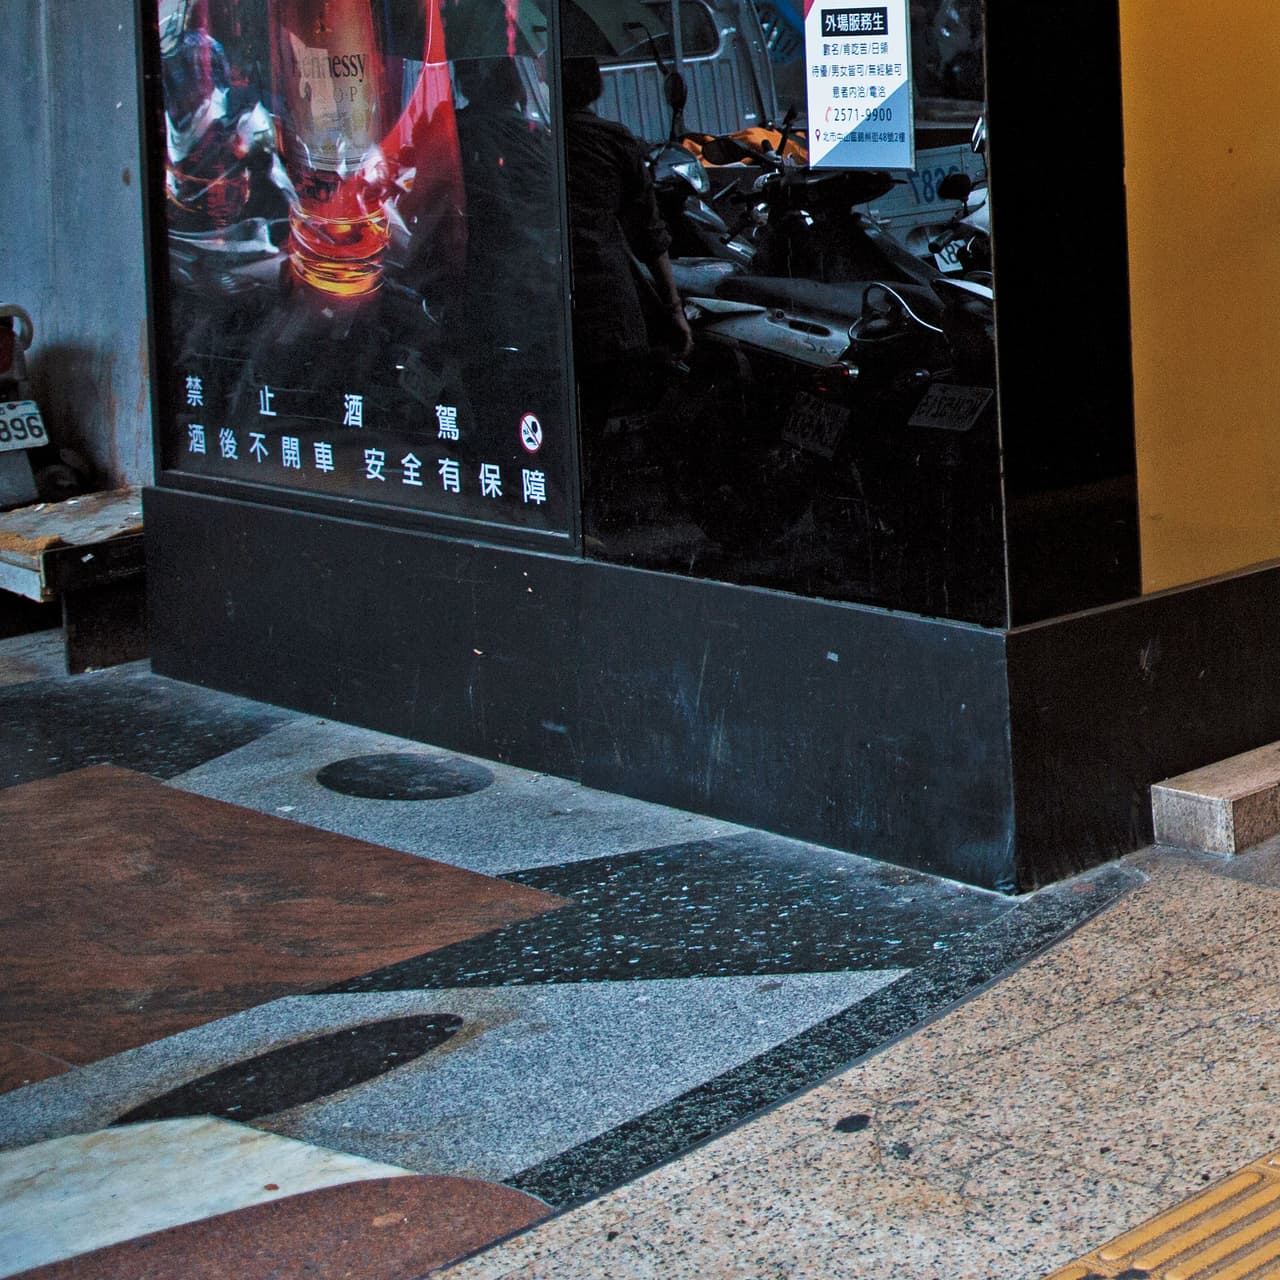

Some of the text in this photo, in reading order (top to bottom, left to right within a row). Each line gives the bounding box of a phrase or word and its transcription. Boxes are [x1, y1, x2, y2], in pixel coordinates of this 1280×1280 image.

[825, 12, 885, 32] 外場服務生
[834, 108, 893, 122] 2571-9900
[186, 375, 459, 441] 禁止酒駕
[187, 424, 547, 505] 酒後不開車 安全有保障
